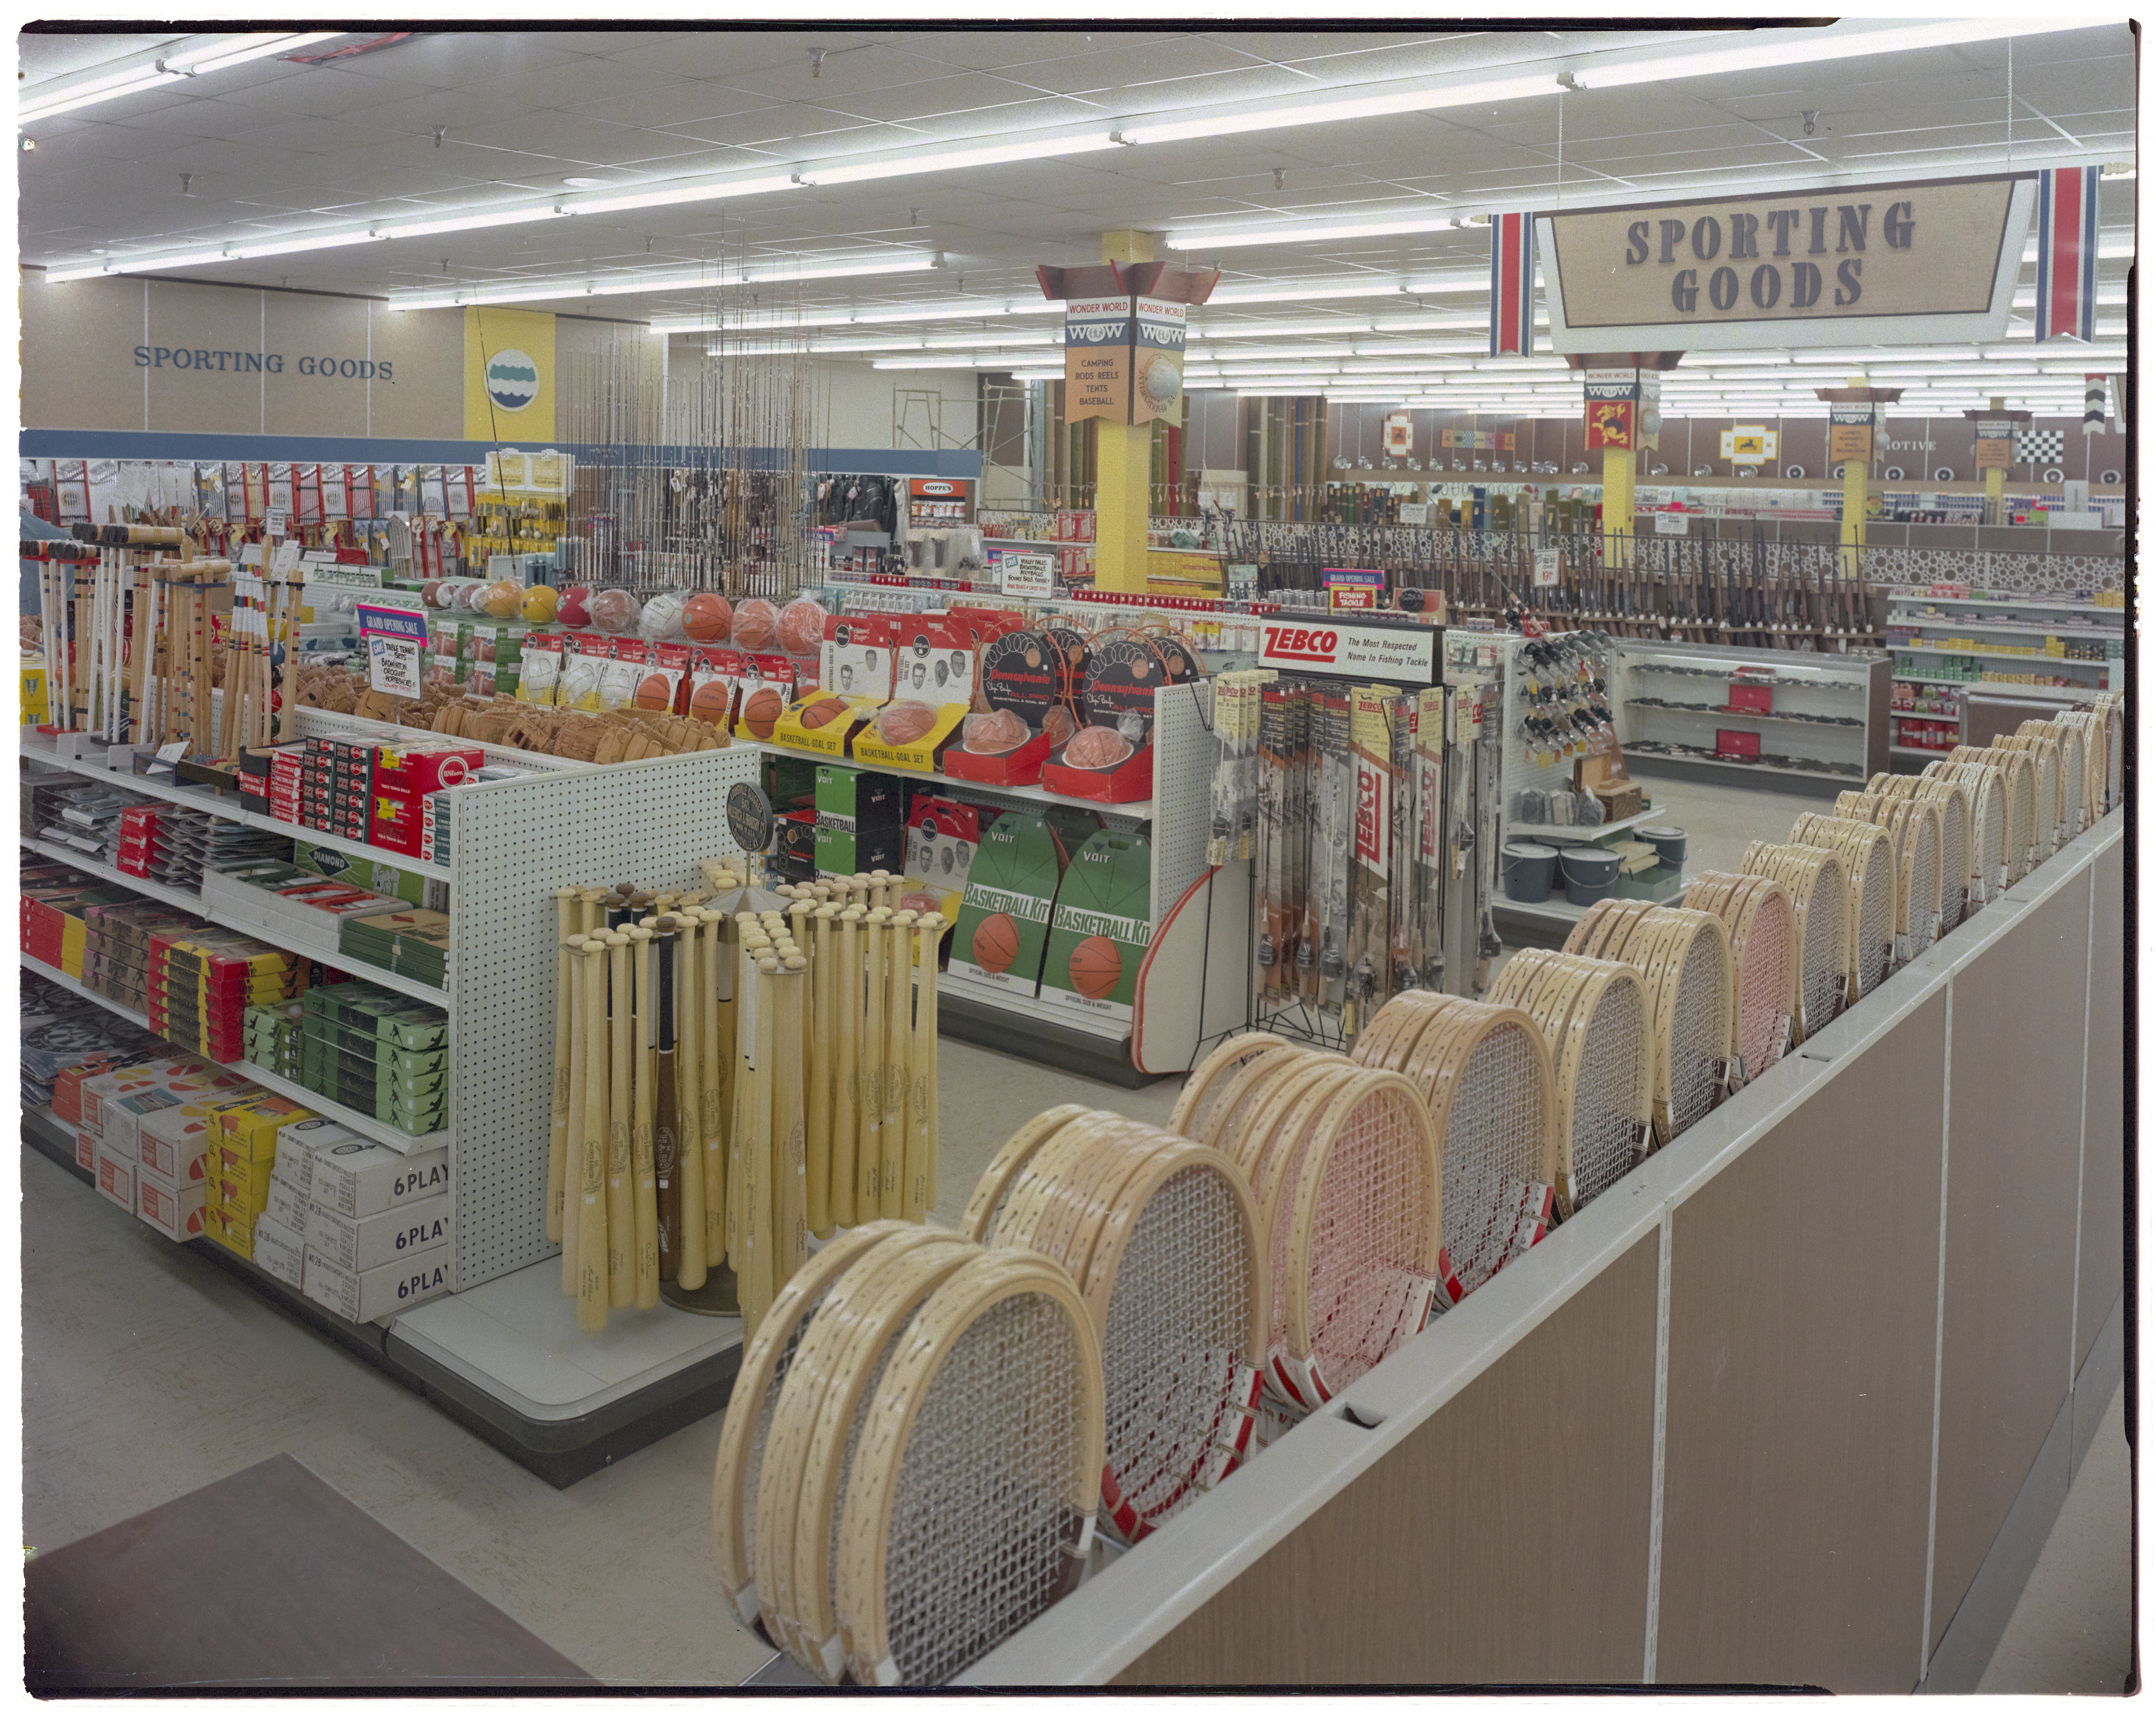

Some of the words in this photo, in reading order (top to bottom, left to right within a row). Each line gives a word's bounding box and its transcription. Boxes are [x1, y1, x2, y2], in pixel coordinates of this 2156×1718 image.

[1626, 201, 1915, 265] SPORTING
[1672, 259, 1863, 313] GOODS
[1069, 303, 1100, 314] WONDER
[1105, 302, 1129, 312] WORLD
[1138, 303, 1164, 315] WONDER
[1165, 307, 1184, 317] WORLD
[1067, 322, 1127, 342] WOW
[1140, 323, 1186, 345] WOW
[133, 346, 285, 374] SPORTING
[298, 356, 394, 381] GOODS
[1081, 358, 1114, 368] CAMPING
[1075, 372, 1094, 381] RODS
[1098, 371, 1119, 380] REELS
[1086, 385, 1108, 393] TENTS
[1587, 385, 1634, 398] WOW
[1079, 397, 1114, 406] BASEBALL
[1833, 413, 1871, 424] WOW
[1886, 441, 1937, 451] OTIVE
[1006, 557, 1017, 567] SAVE
[1330, 574, 1345, 582] GRAND
[1345, 575, 1363, 583] OPENING
[1364, 575, 1376, 583] SALE
[1339, 599, 1364, 607] TACKLE
[367, 615, 384, 631] GRAND
[384, 618, 406, 633] OPENING
[405, 622, 419, 635] SALE
[373, 641, 384, 654] SAVE
[386, 643, 399, 652] TABLE
[400, 645, 416, 655] TENNIS
[1263, 626, 1338, 664] ZEBCO
[1348, 637, 1360, 647] The
[1362, 638, 1380, 649] Most
[1382, 640, 1418, 652] Respected
[394, 651, 407, 661] SETS
[1348, 651, 1366, 662] Name
[1369, 654, 1376, 662] In
[1378, 654, 1404, 666] Fishing
[1406, 656, 1428, 668] Tackle
[381, 658, 407, 670] BADMINTON
[385, 676, 412, 687] HORSESHOES
[990, 668, 1050, 685] Pennsylvania
[1091, 680, 1154, 697] Pennsylvania
[1029, 693, 1050, 701] PRO
[1112, 703, 1129, 712] ALL
[1133, 706, 1154, 715] PRO
[1357, 701, 1383, 714] ZEBCO
[1424, 701, 1439, 712] ZEBCO
[827, 742, 836, 751] SET
[914, 754, 924, 763] SET
[817, 775, 833, 784] VOIT
[871, 794, 885, 802] VOIT
[815, 810, 856, 833] BASKETBALL
[1356, 771, 1381, 864] ZEBCO
[817, 835, 833, 844] VOIT
[991, 831, 1014, 844] VOIT
[313, 850, 345, 869] DIAMOND
[870, 854, 885, 862] VOIT
[1083, 851, 1110, 864] VOIT
[963, 883, 1029, 916] BASKETBALL
[1053, 905, 1131, 943] BASKETBALL
[969, 967, 983, 977] OFFICIAL
[996, 975, 1010, 984] WEIGHT
[1065, 994, 1081, 1005] OFFICIAL
[1082, 998, 1091, 1007] SIZE
[1096, 1002, 1112, 1011] WEIGHT
